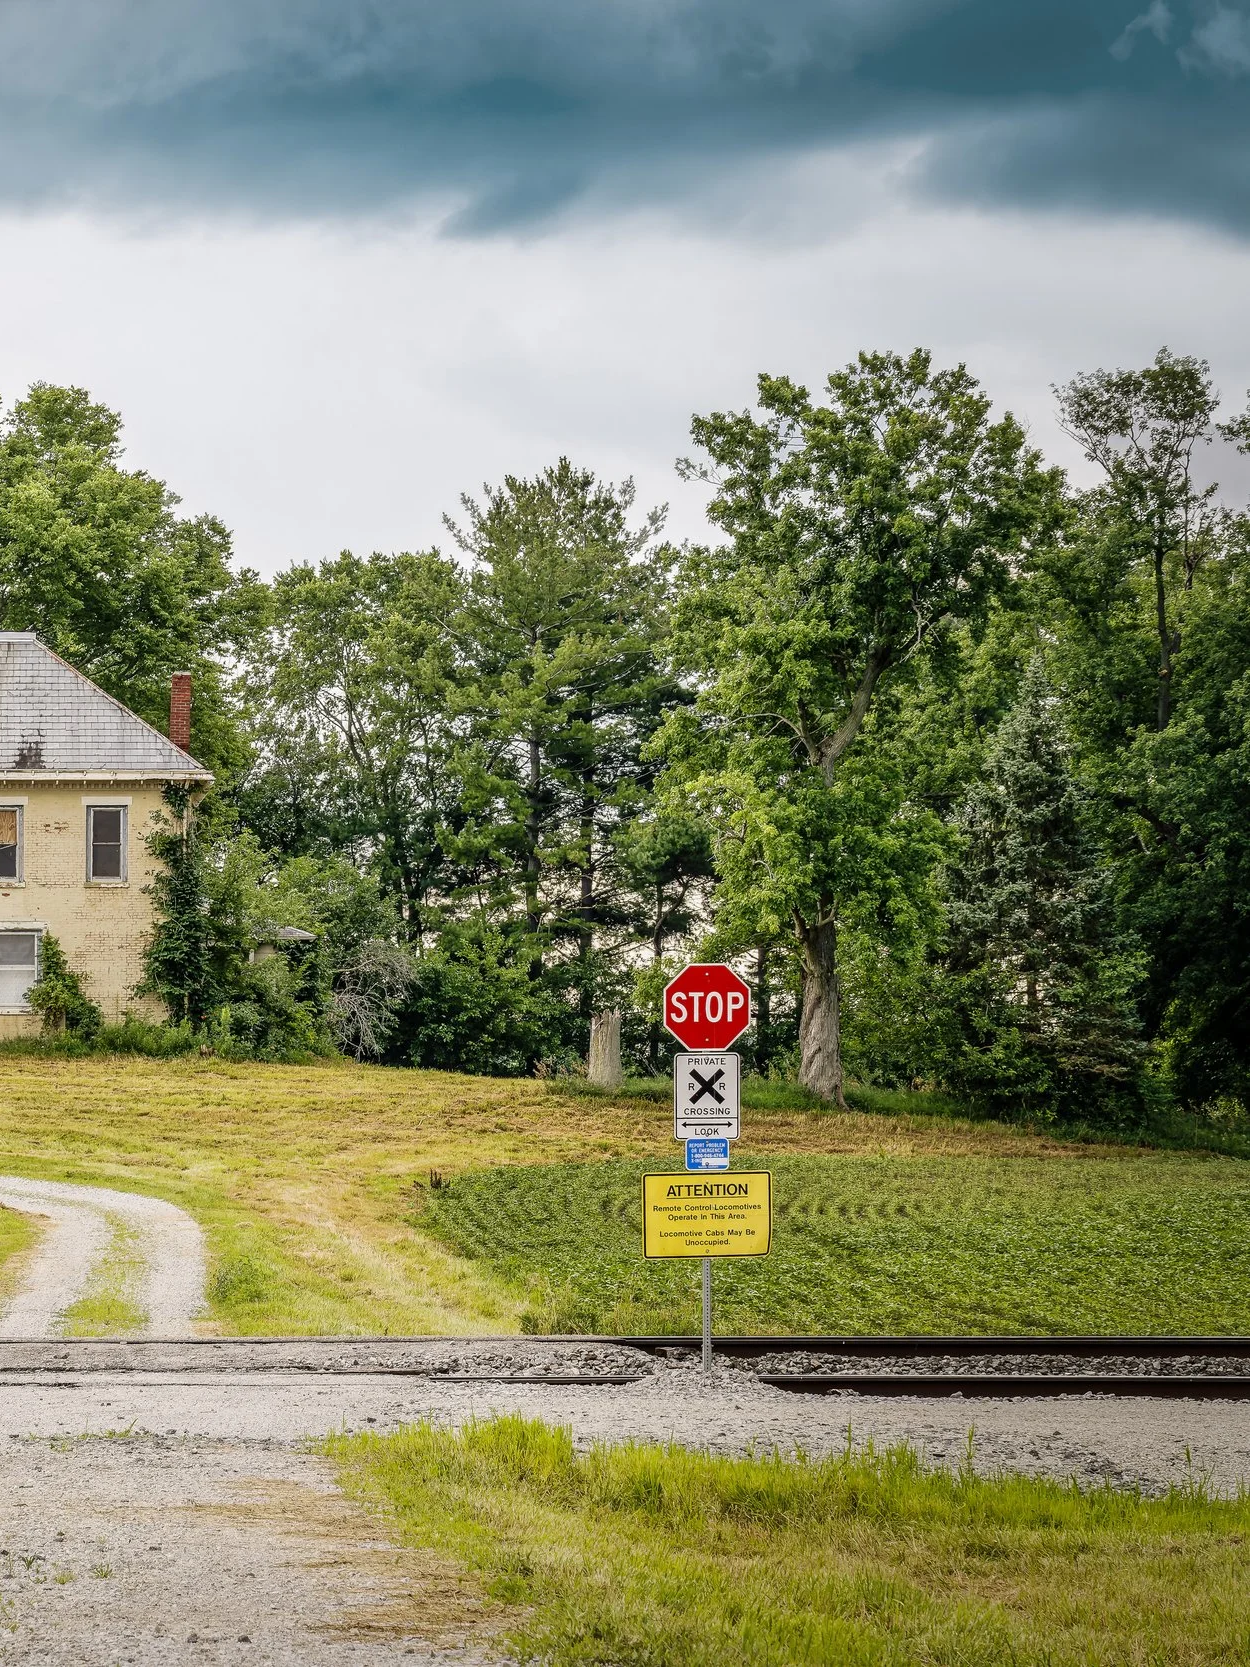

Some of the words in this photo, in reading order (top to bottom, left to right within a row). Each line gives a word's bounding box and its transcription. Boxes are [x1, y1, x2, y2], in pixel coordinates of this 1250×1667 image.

[670, 991, 745, 1023] STOP
[687, 1057, 726, 1065] PRIVATE
[688, 1082, 695, 1091] R
[718, 1082, 726, 1091] R
[683, 1107, 731, 1116] CROSSING
[694, 1128, 720, 1136] LOOK
[666, 1183, 749, 1197] ATTENTION
[684, 1204, 712, 1212] Control
[714, 1203, 762, 1211] Locomotives
[668, 1213, 698, 1222] Operate
[659, 1230, 703, 1238] Locomotive
[705, 1229, 725, 1237] Cabs
[727, 1229, 743, 1238] May
[745, 1228, 756, 1236] Be
[685, 1238, 731, 1247] Unoccupied.
